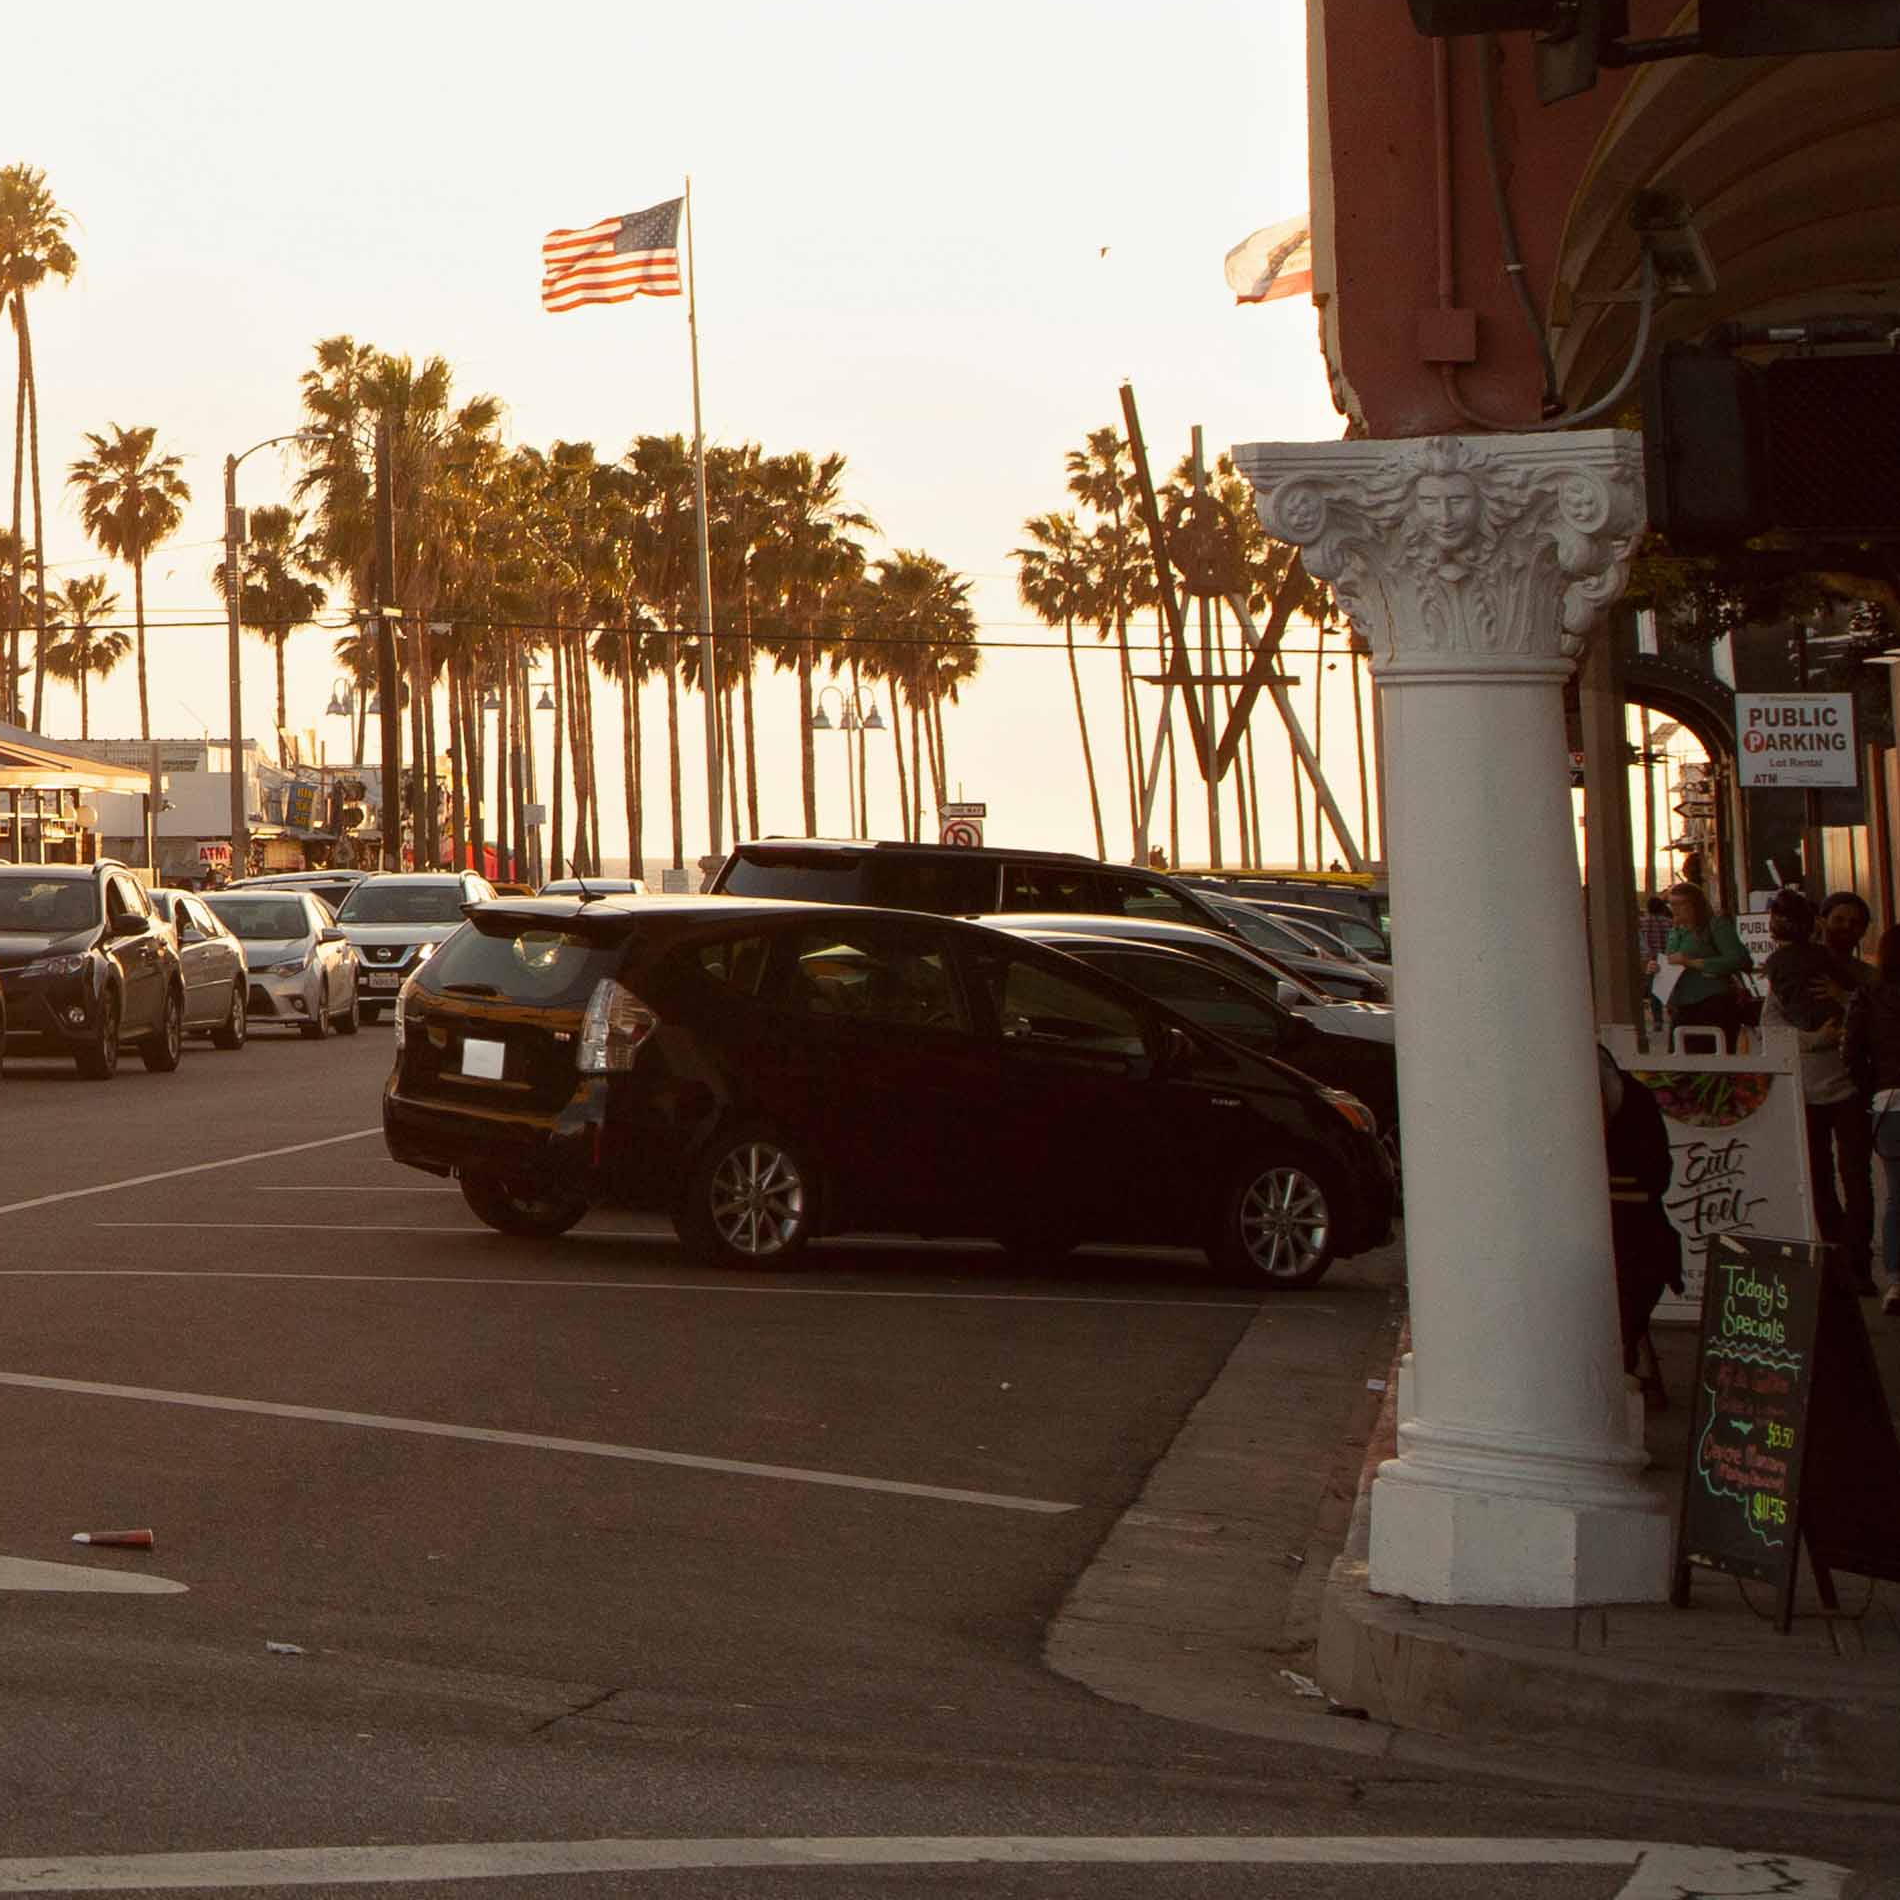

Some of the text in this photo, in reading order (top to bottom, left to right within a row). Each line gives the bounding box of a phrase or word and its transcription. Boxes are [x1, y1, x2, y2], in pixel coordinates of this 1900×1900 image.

[1749, 707, 1839, 727] PUBLIC
[1743, 730, 1847, 754] PARKING
[1753, 773, 1779, 785] ATM
[199, 846, 228, 861] ATM
[1740, 922, 1768, 934] PUBL
[1719, 1264, 1789, 1316] Today's
[1722, 1296, 1786, 1345] Specials
